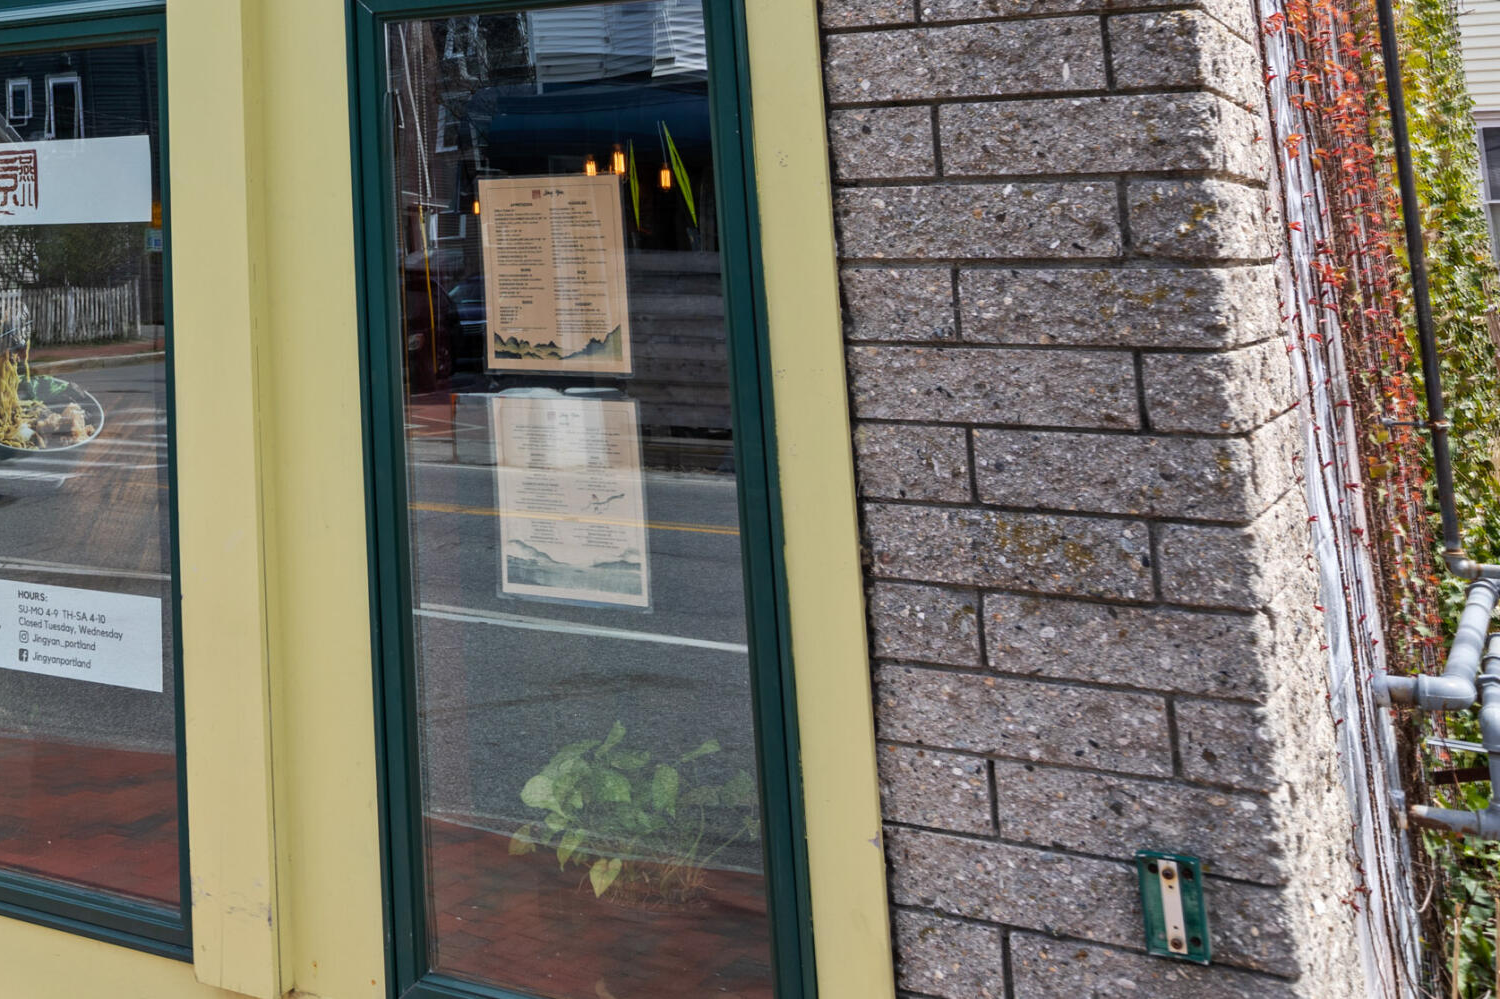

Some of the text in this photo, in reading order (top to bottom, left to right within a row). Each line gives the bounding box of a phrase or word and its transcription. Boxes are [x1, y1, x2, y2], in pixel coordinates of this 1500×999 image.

[17, 589, 48, 602] HOURS:
[18, 605, 106, 624] SU-MO 4-9 TH-SA 4-10
[18, 616, 124, 641] Closed Tuesday, Wednesday
[32, 634, 96, 652] Jingyan_portland
[32, 651, 92, 670] Jingyanportland
